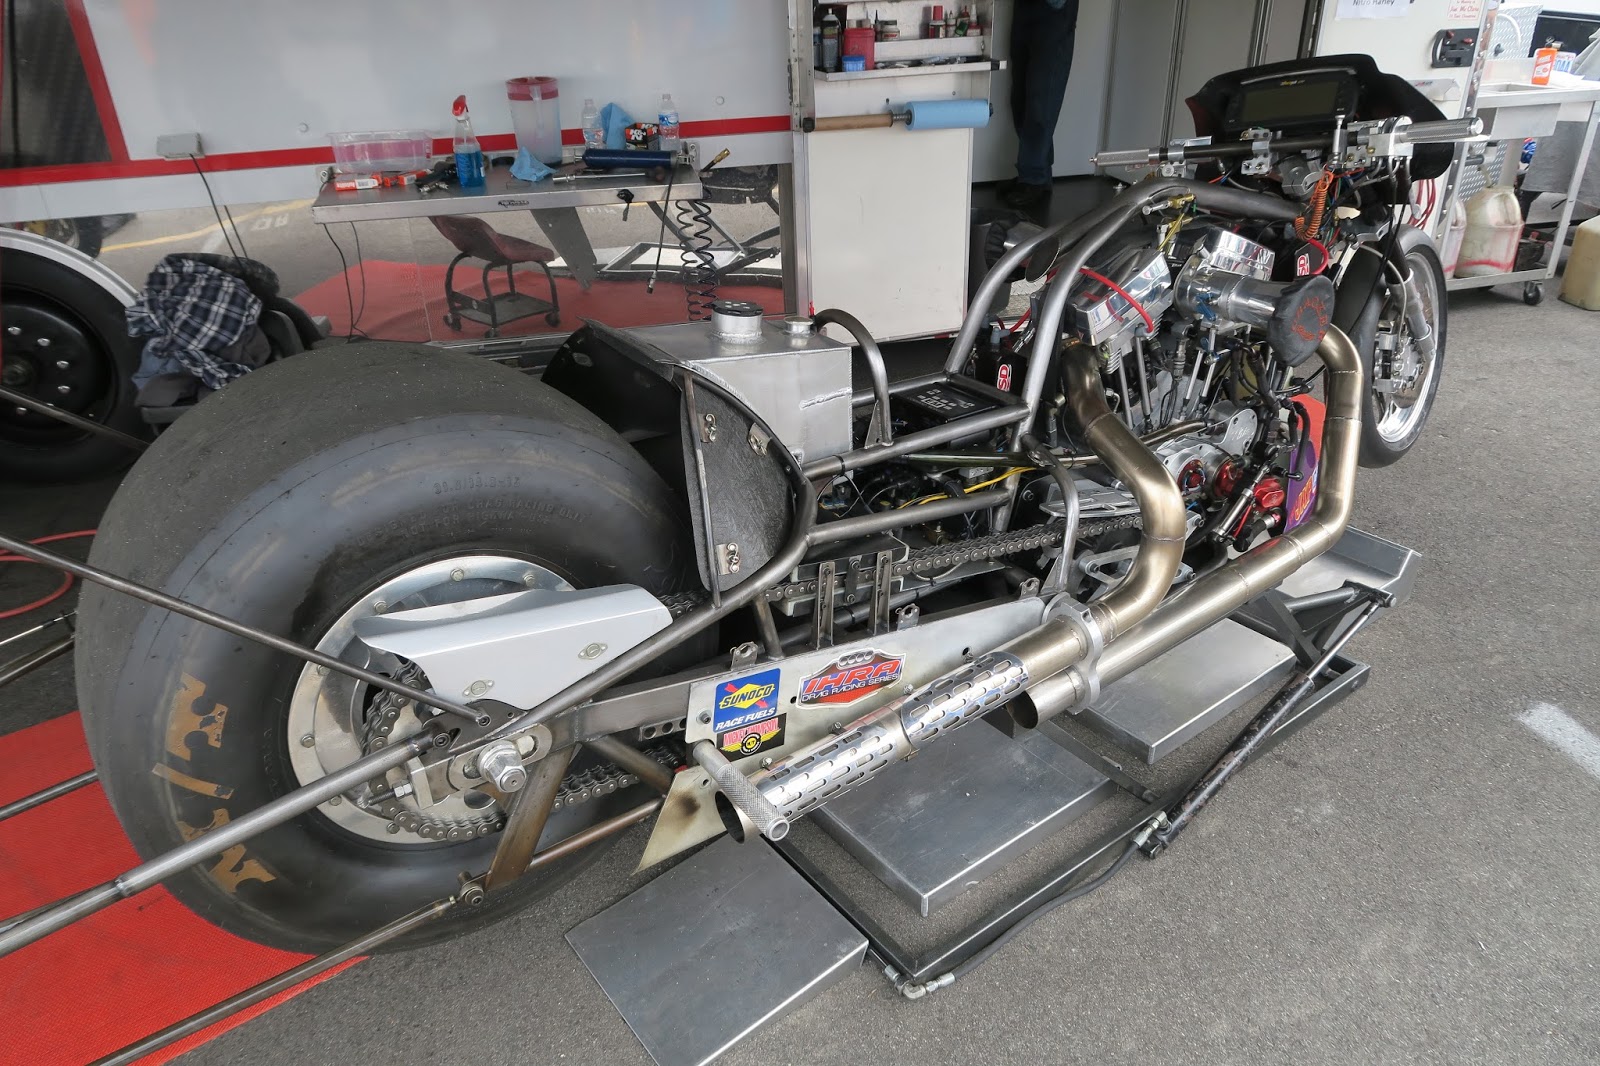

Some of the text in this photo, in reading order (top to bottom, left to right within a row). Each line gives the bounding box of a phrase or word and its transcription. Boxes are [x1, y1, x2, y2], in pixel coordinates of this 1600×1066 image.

[802, 673, 899, 702] DRAG RACING SERIES
[804, 660, 901, 695] IHRA
[721, 685, 773, 708] SUNOCO
[715, 707, 776, 731] RACE FUELS
[723, 729, 745, 748] MICKEY
